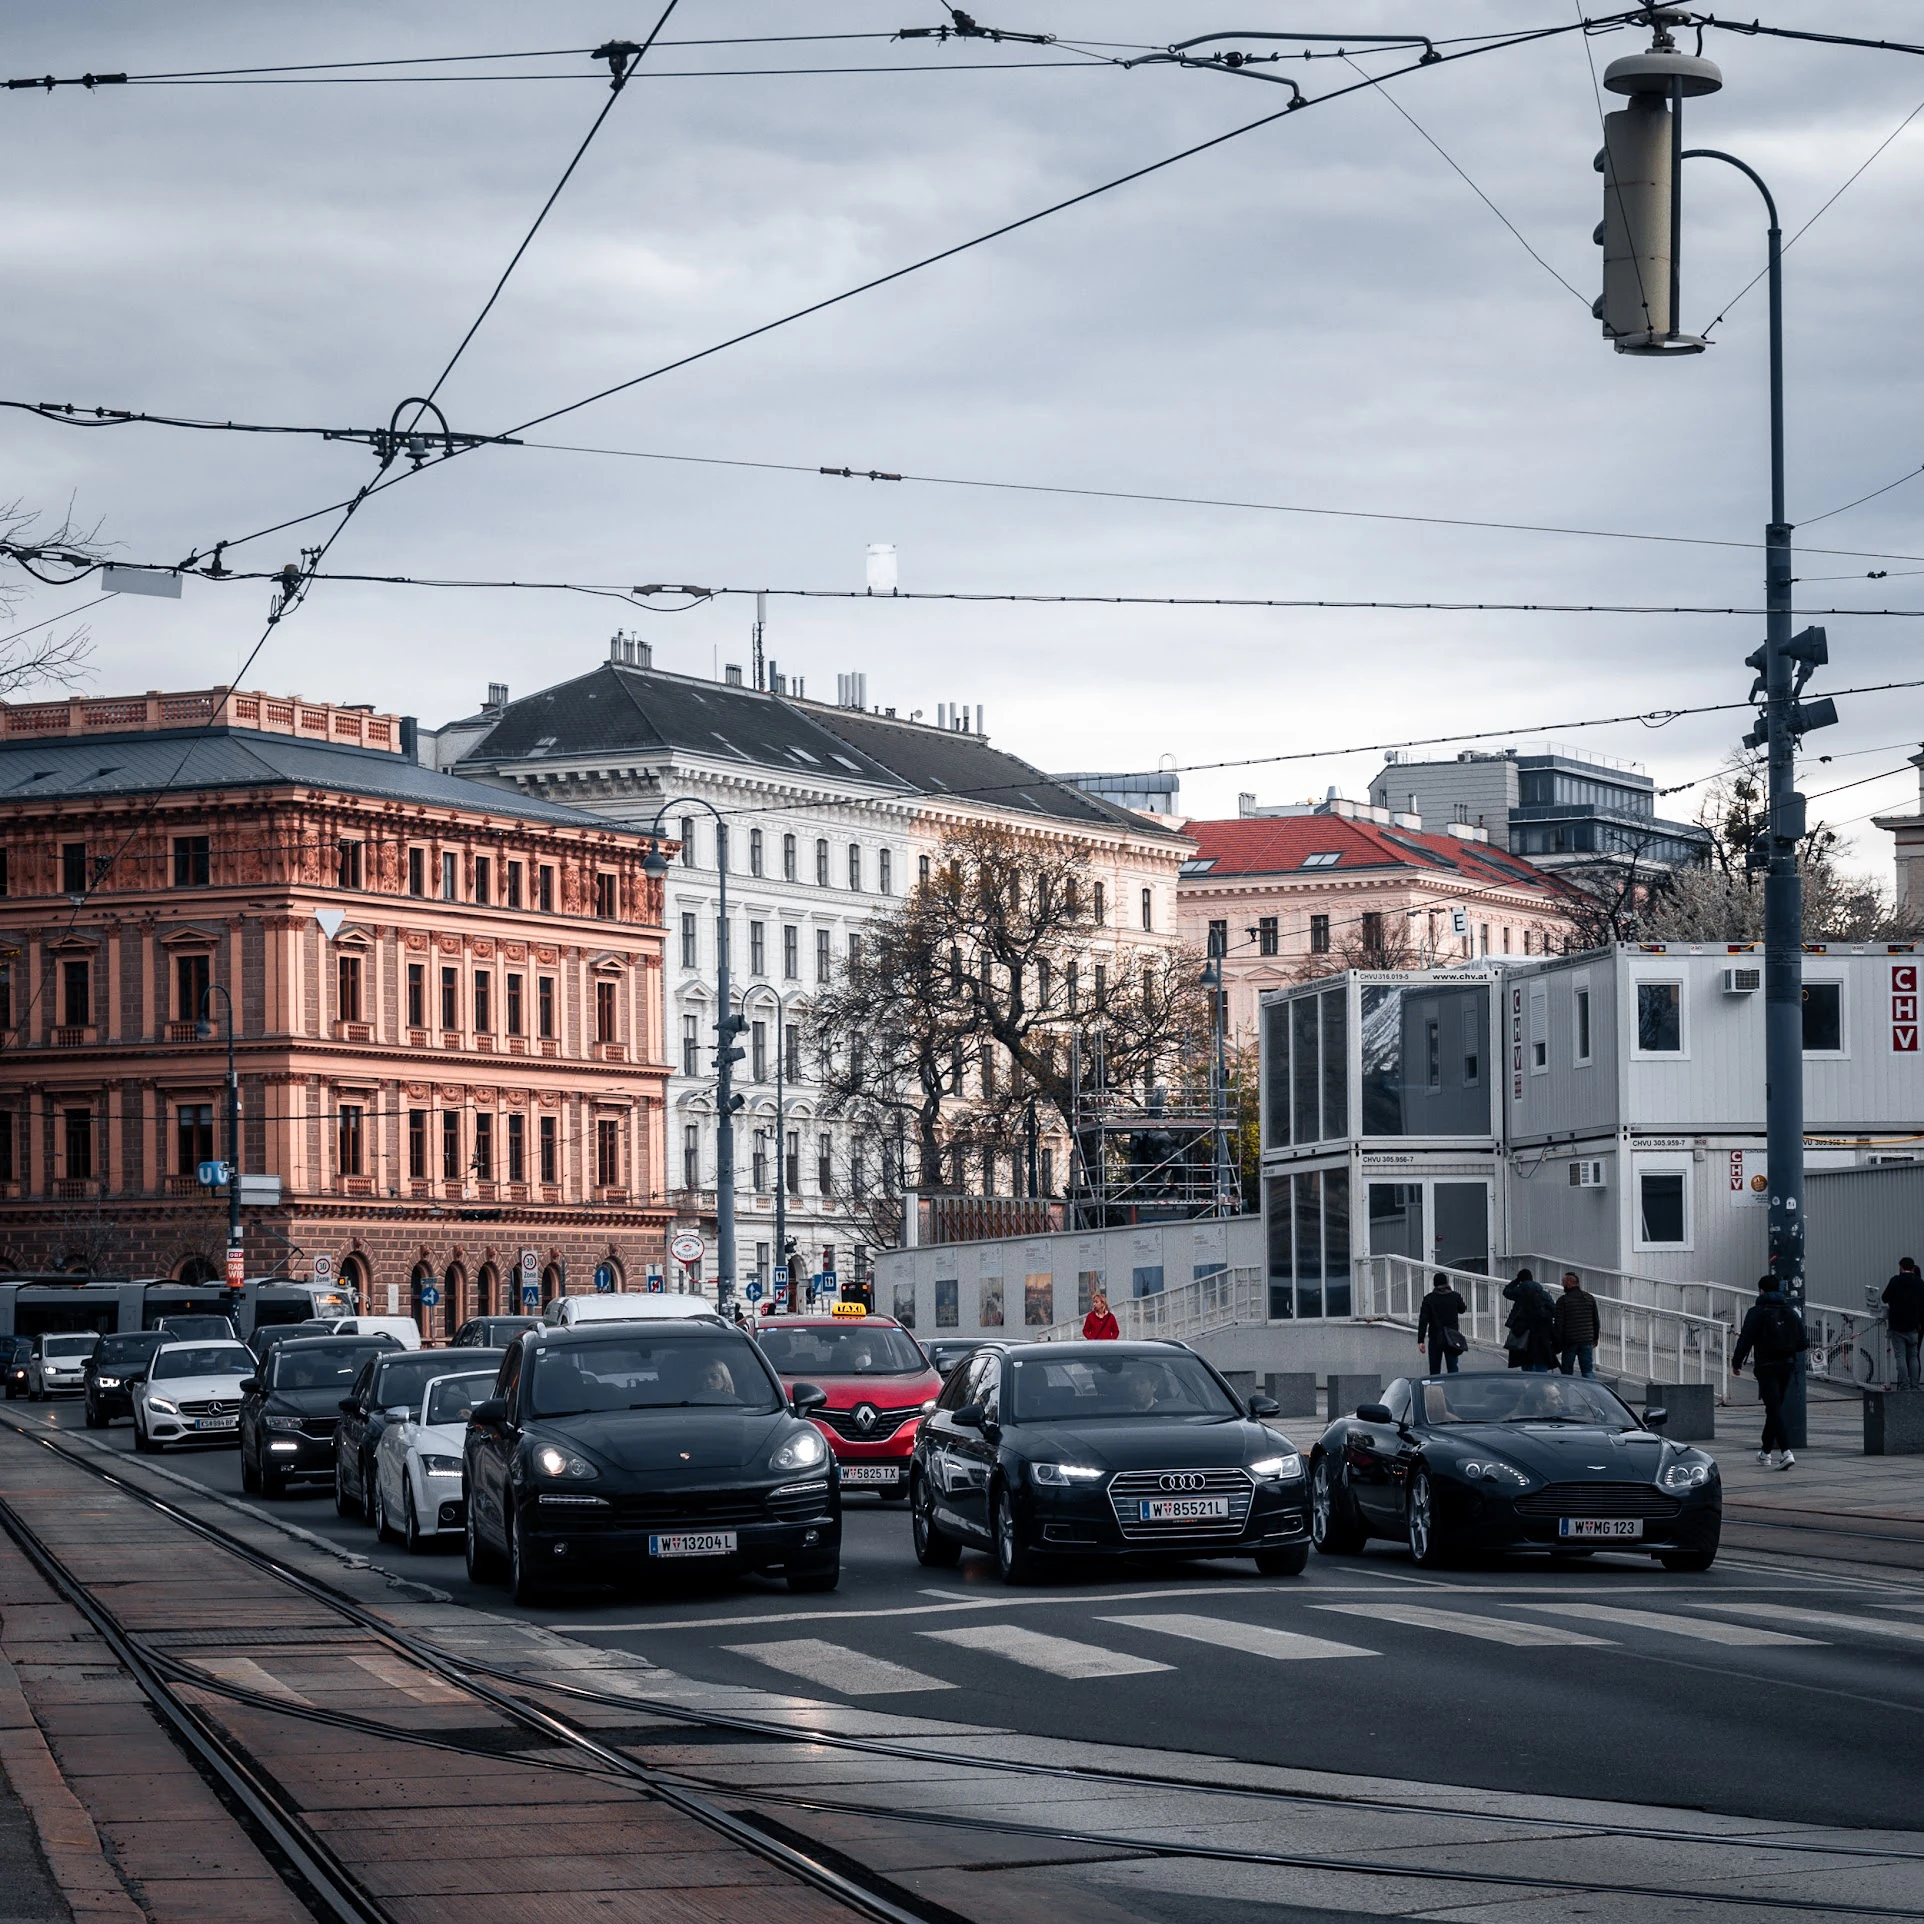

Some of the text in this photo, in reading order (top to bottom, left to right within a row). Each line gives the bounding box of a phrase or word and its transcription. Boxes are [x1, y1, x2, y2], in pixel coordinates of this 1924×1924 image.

[1454, 914, 1465, 931] E
[1895, 968, 1916, 1049] CHV
[199, 1167, 213, 1184] U
[1731, 1151, 1742, 1190] CHV
[319, 1262, 327, 1270] 30
[526, 1257, 534, 1266] 30
[524, 1271, 537, 1279] Zone
[837, 1305, 862, 1313] TAXI
[842, 1468, 896, 1479] W 5825 TX
[1153, 1503, 1162, 1517] W
[1575, 1521, 1584, 1534] W
[1594, 1521, 1611, 1534] MG
[1613, 1521, 1635, 1534] 123
[661, 1537, 671, 1551] W
